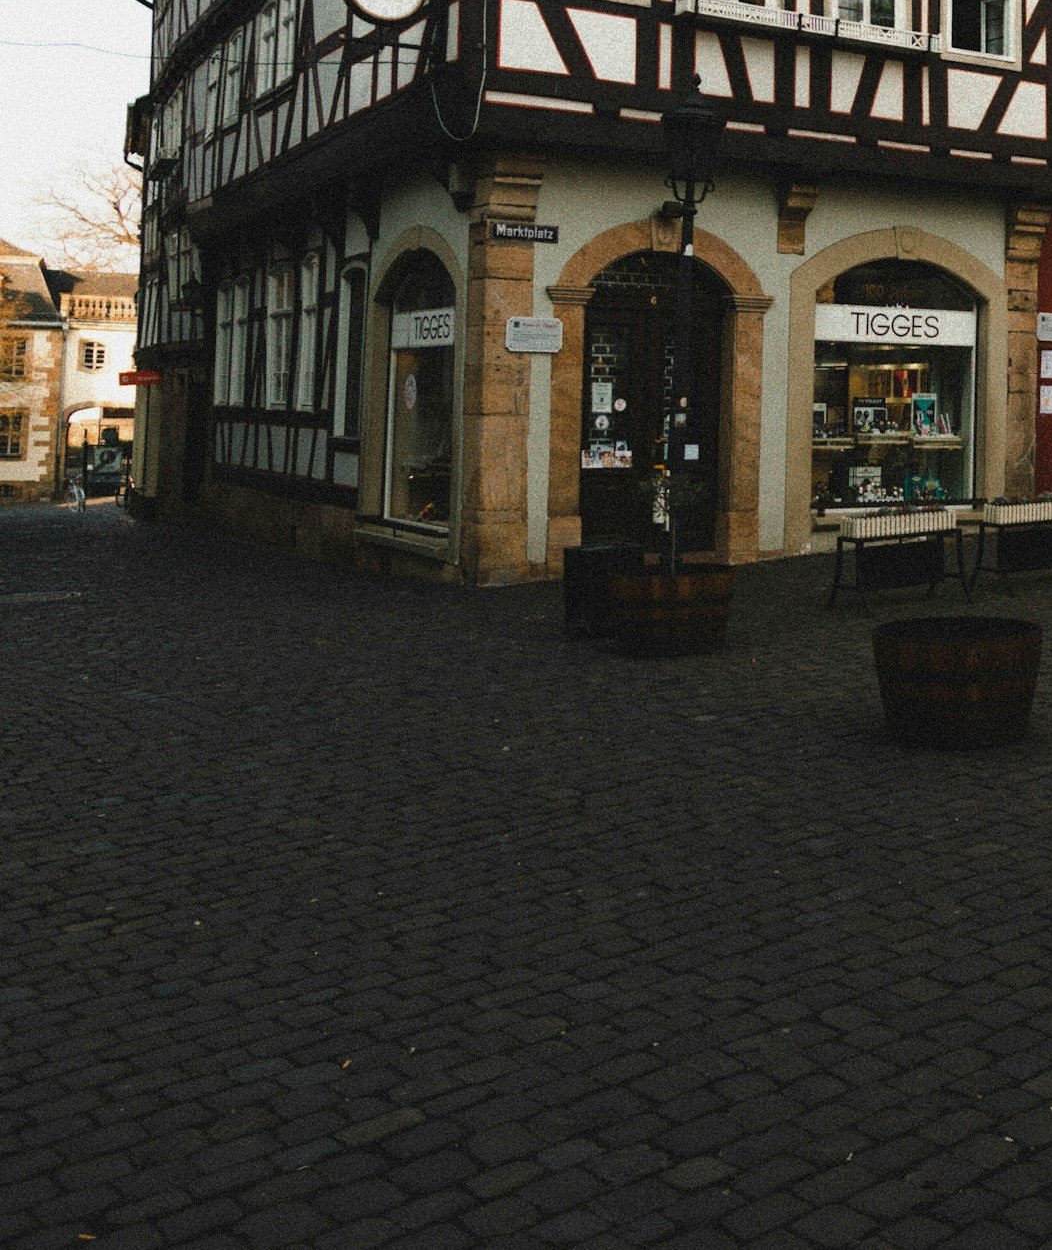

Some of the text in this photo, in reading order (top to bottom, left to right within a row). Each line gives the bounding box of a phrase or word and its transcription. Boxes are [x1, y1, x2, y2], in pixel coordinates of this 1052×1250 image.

[496, 223, 554, 240] Marktplatz
[414, 314, 450, 340] TIGGES
[851, 312, 939, 338] TIGGES
